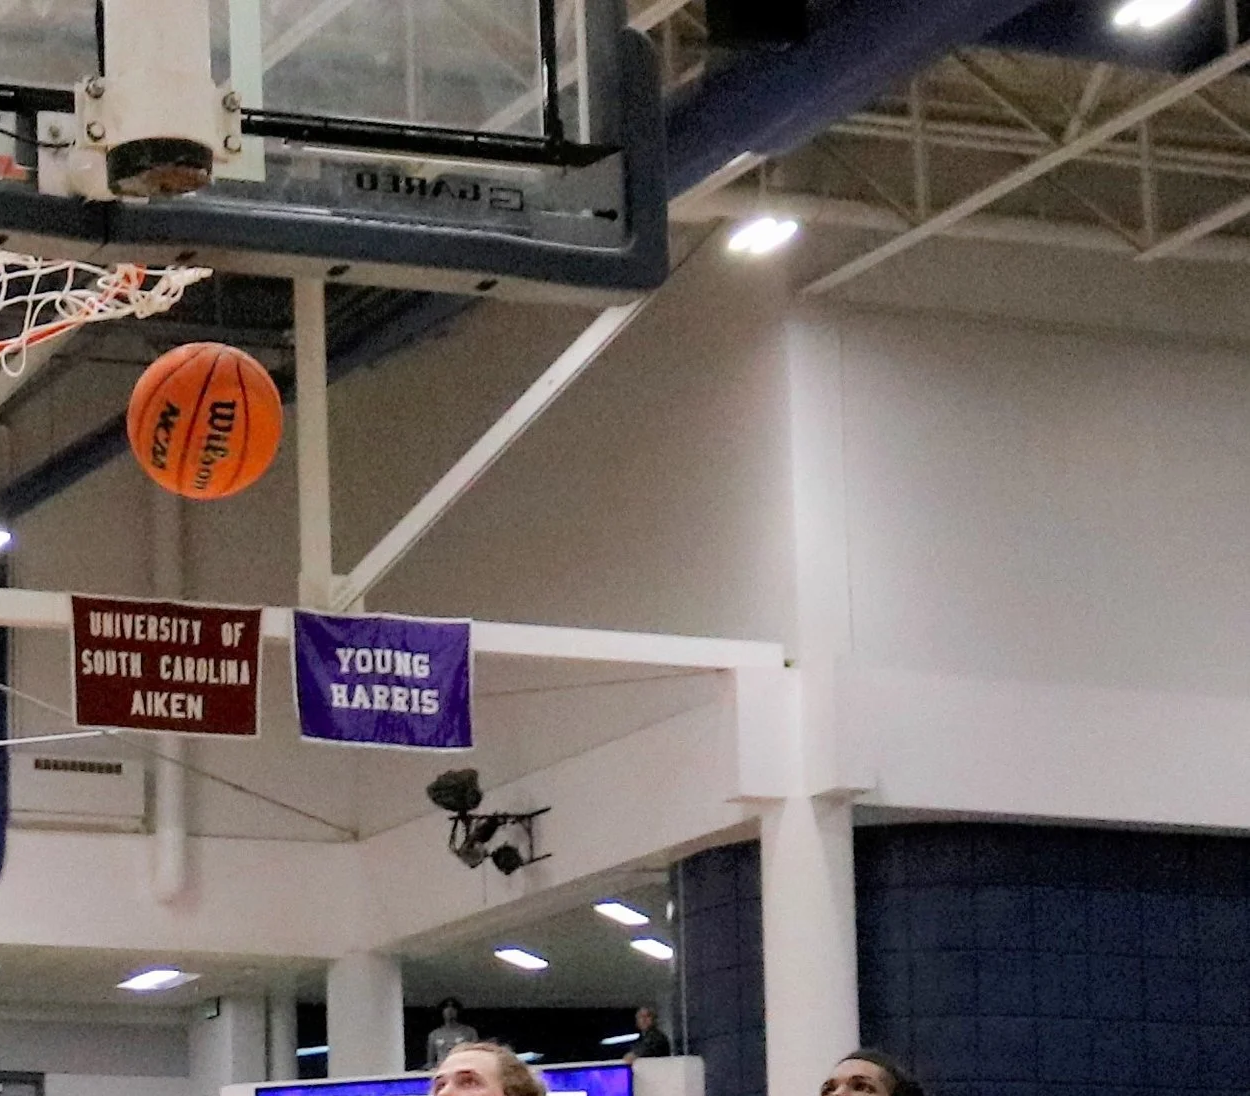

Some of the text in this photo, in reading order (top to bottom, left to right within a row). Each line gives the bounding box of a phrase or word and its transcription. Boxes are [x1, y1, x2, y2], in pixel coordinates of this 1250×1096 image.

[89, 611, 247, 649] UNIVERSITY OF
[81, 648, 251, 686] SOUTH CAROLINA
[335, 647, 432, 680] YOUNG
[130, 689, 204, 721] AIKEN
[329, 682, 441, 716] HARRIS
